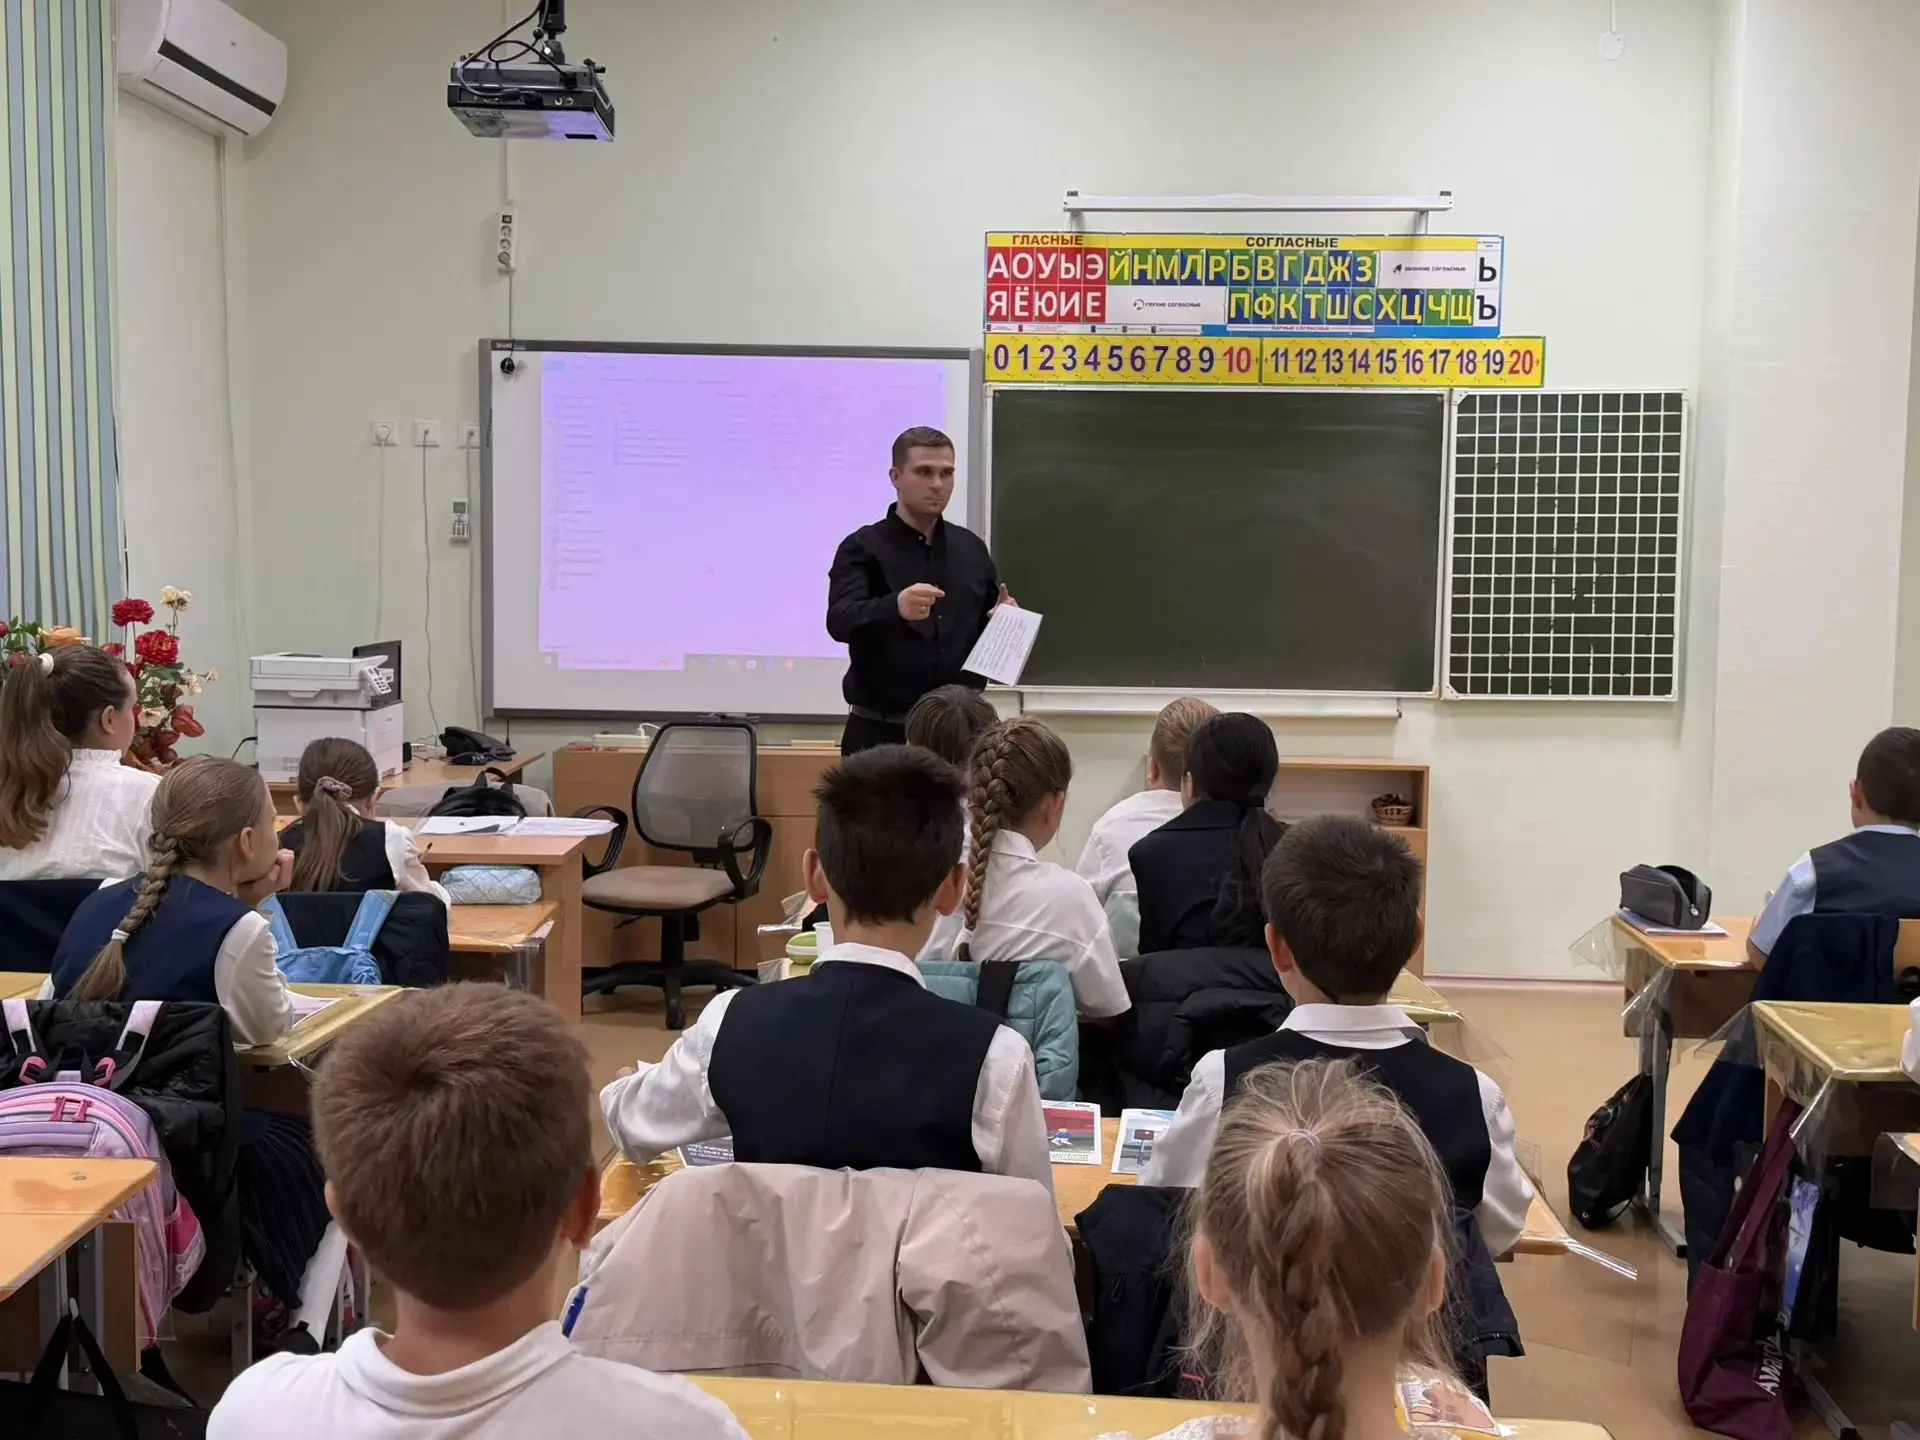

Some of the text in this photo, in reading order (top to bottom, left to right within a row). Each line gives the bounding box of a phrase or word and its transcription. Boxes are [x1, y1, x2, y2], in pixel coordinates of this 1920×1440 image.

[1012, 234, 1083, 246] ГЛАСНЫЕ
[1246, 237, 1338, 248] СОГЛАСНЫЕ
[1478, 257, 1497, 282] Ь
[1476, 295, 1497, 320] Ъ
[994, 344, 1251, 373] 0 1 2 3 4 5 6 7 8 9 10
[1271, 348, 1533, 375] 11 12 13 14 15 16 17 18 19 20
